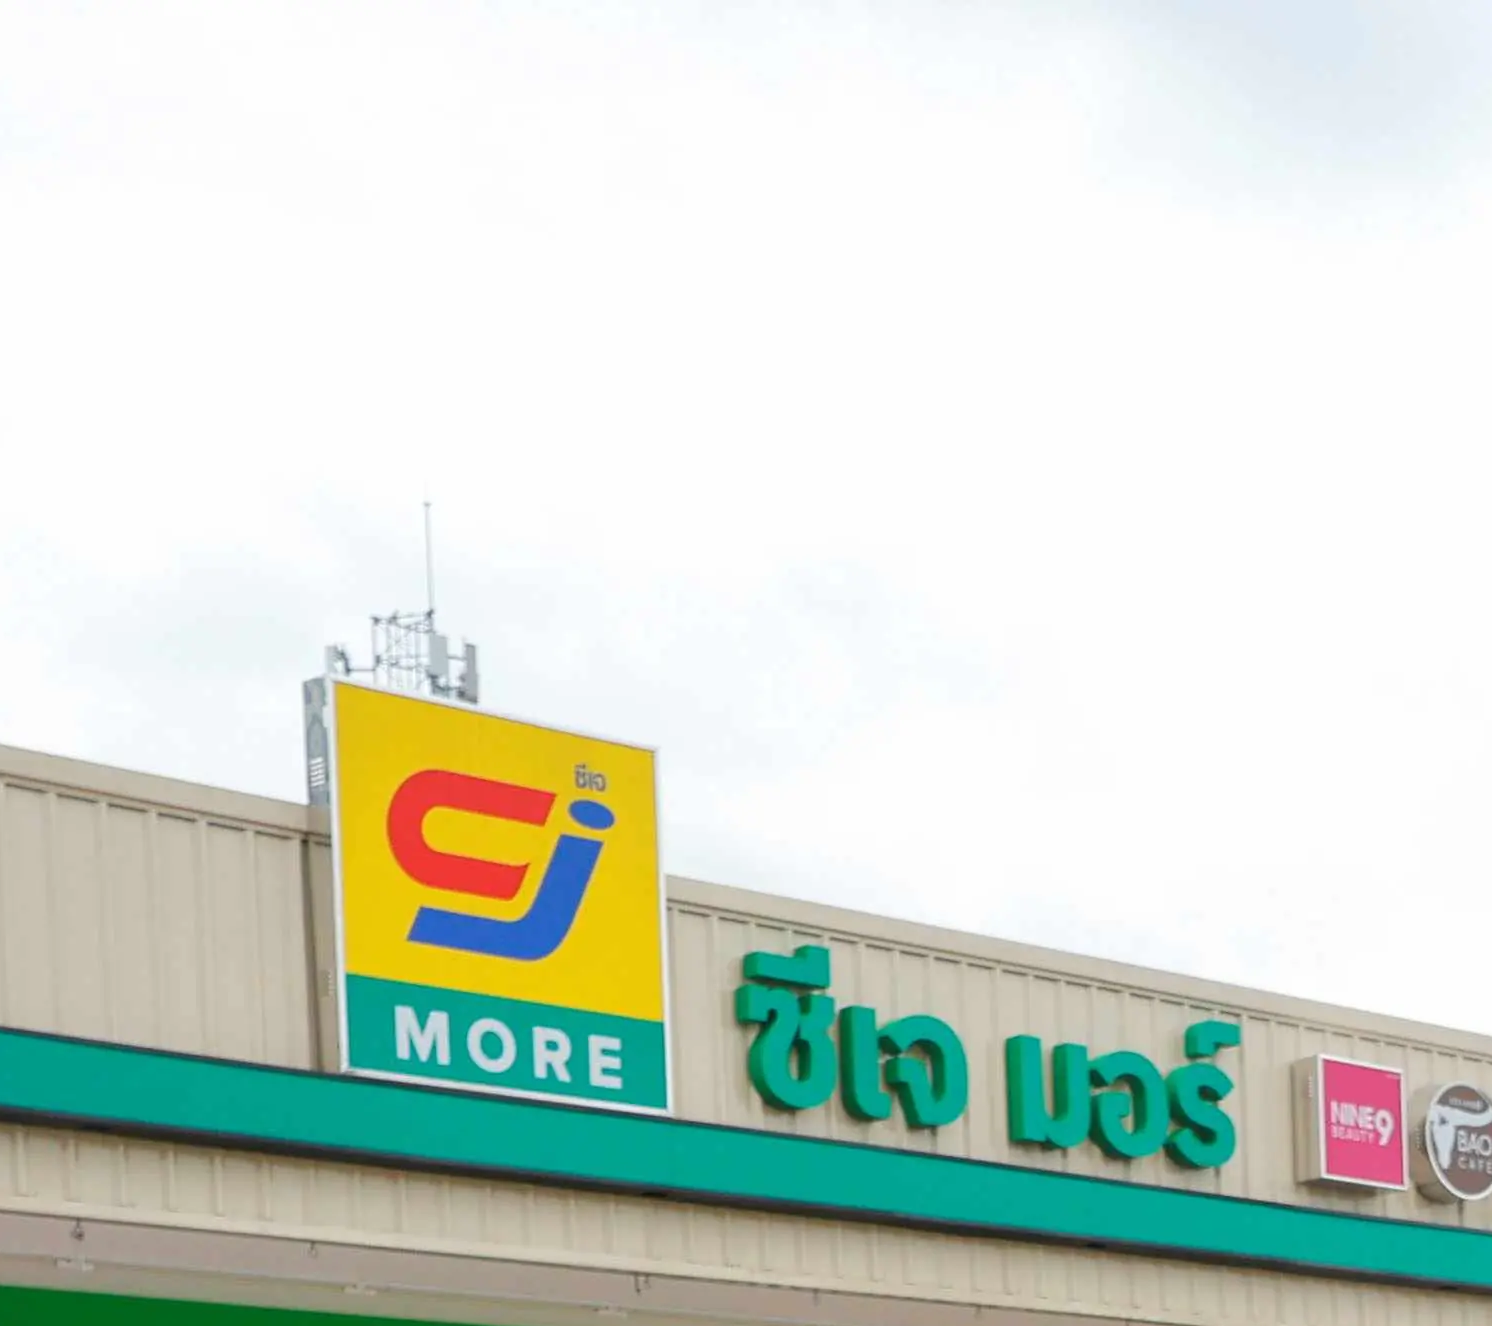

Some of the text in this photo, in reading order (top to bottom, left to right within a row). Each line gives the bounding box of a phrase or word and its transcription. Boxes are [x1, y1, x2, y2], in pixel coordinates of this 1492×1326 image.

[394, 1005, 623, 1090] MORE
[734, 945, 1240, 1168] ซีเจ มอร์
